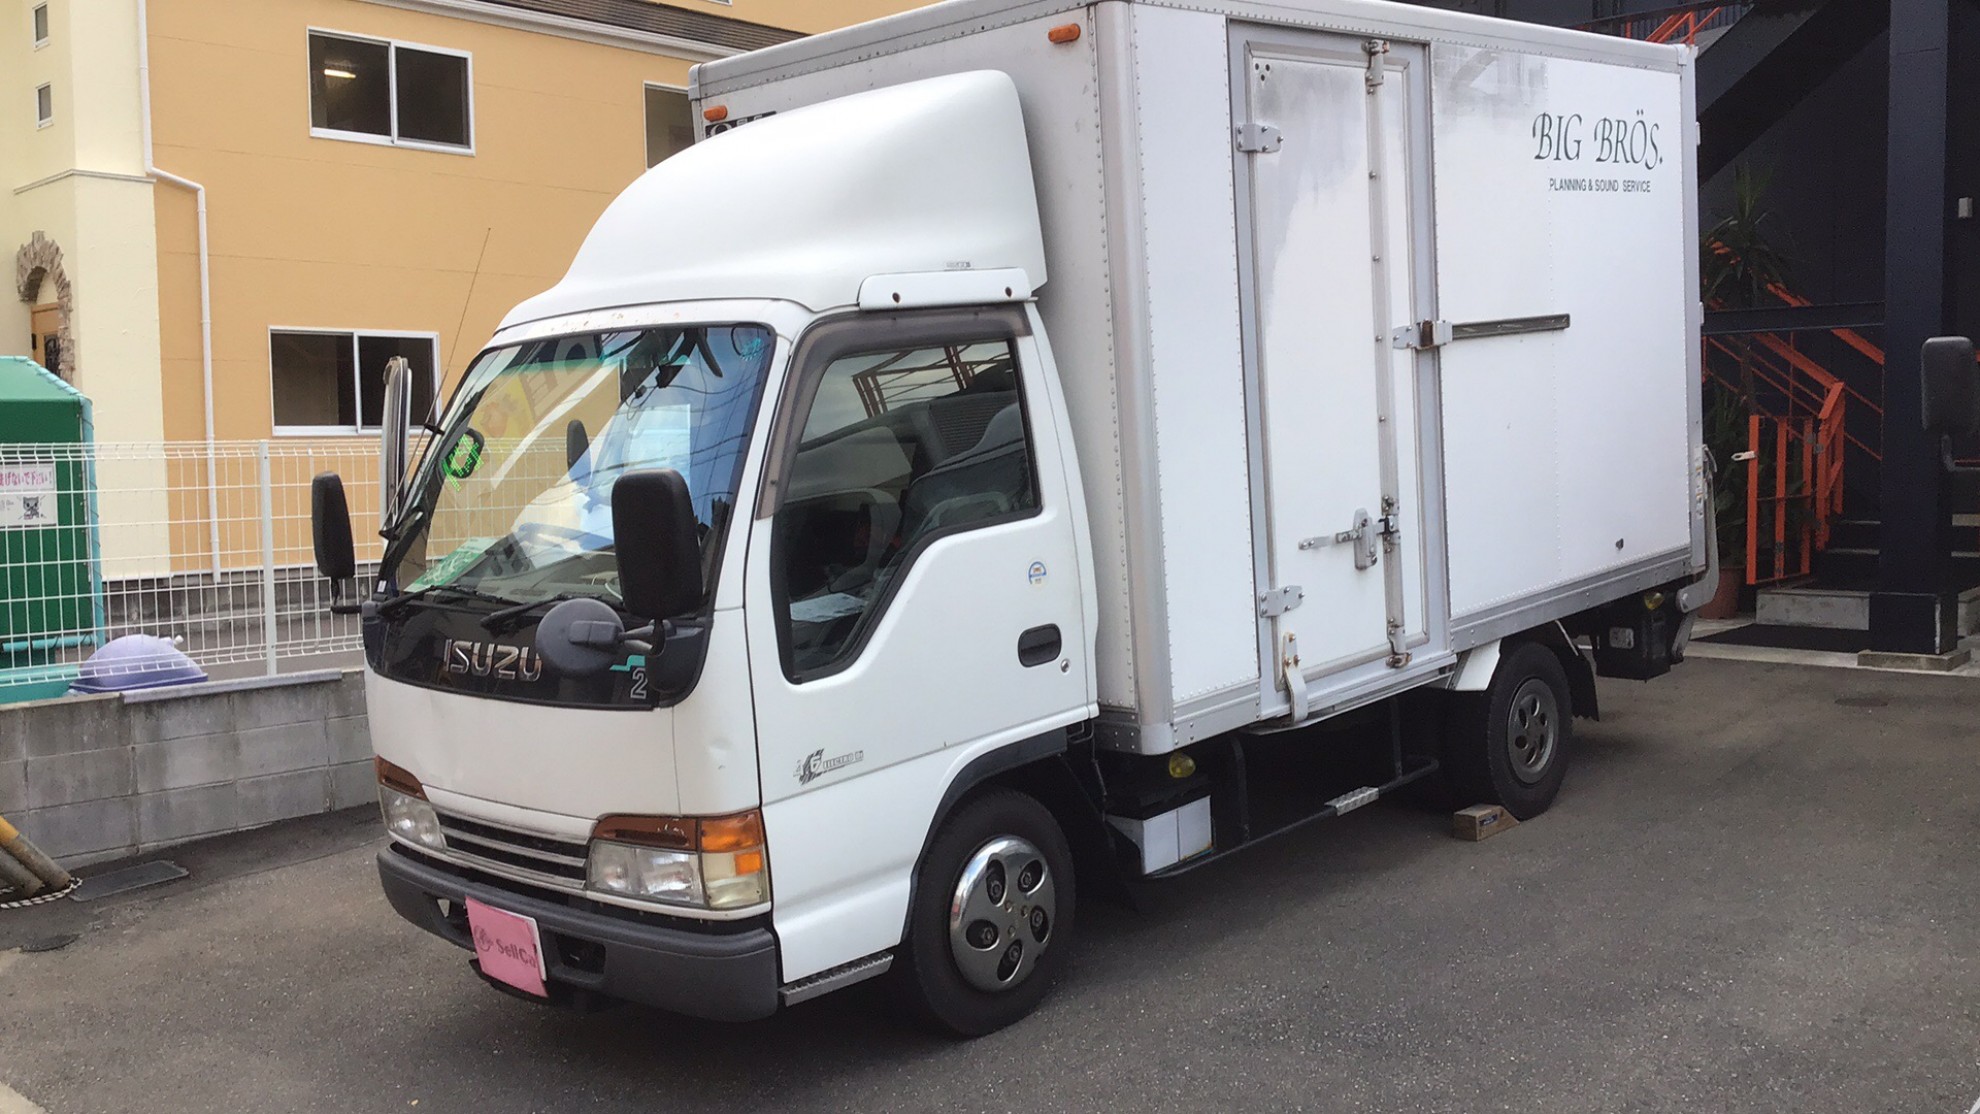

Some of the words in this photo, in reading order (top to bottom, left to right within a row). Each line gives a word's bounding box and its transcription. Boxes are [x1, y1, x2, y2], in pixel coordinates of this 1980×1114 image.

[1532, 112, 1583, 161] BIG
[1593, 109, 1664, 171] BRÖS.
[1549, 177, 1587, 192] PLANNING
[1588, 180, 1594, 192] &
[1595, 178, 1619, 192] SOUND
[1622, 179, 1651, 193] SERVICE
[442, 638, 543, 682] ISUZU
[629, 667, 649, 700] 2
